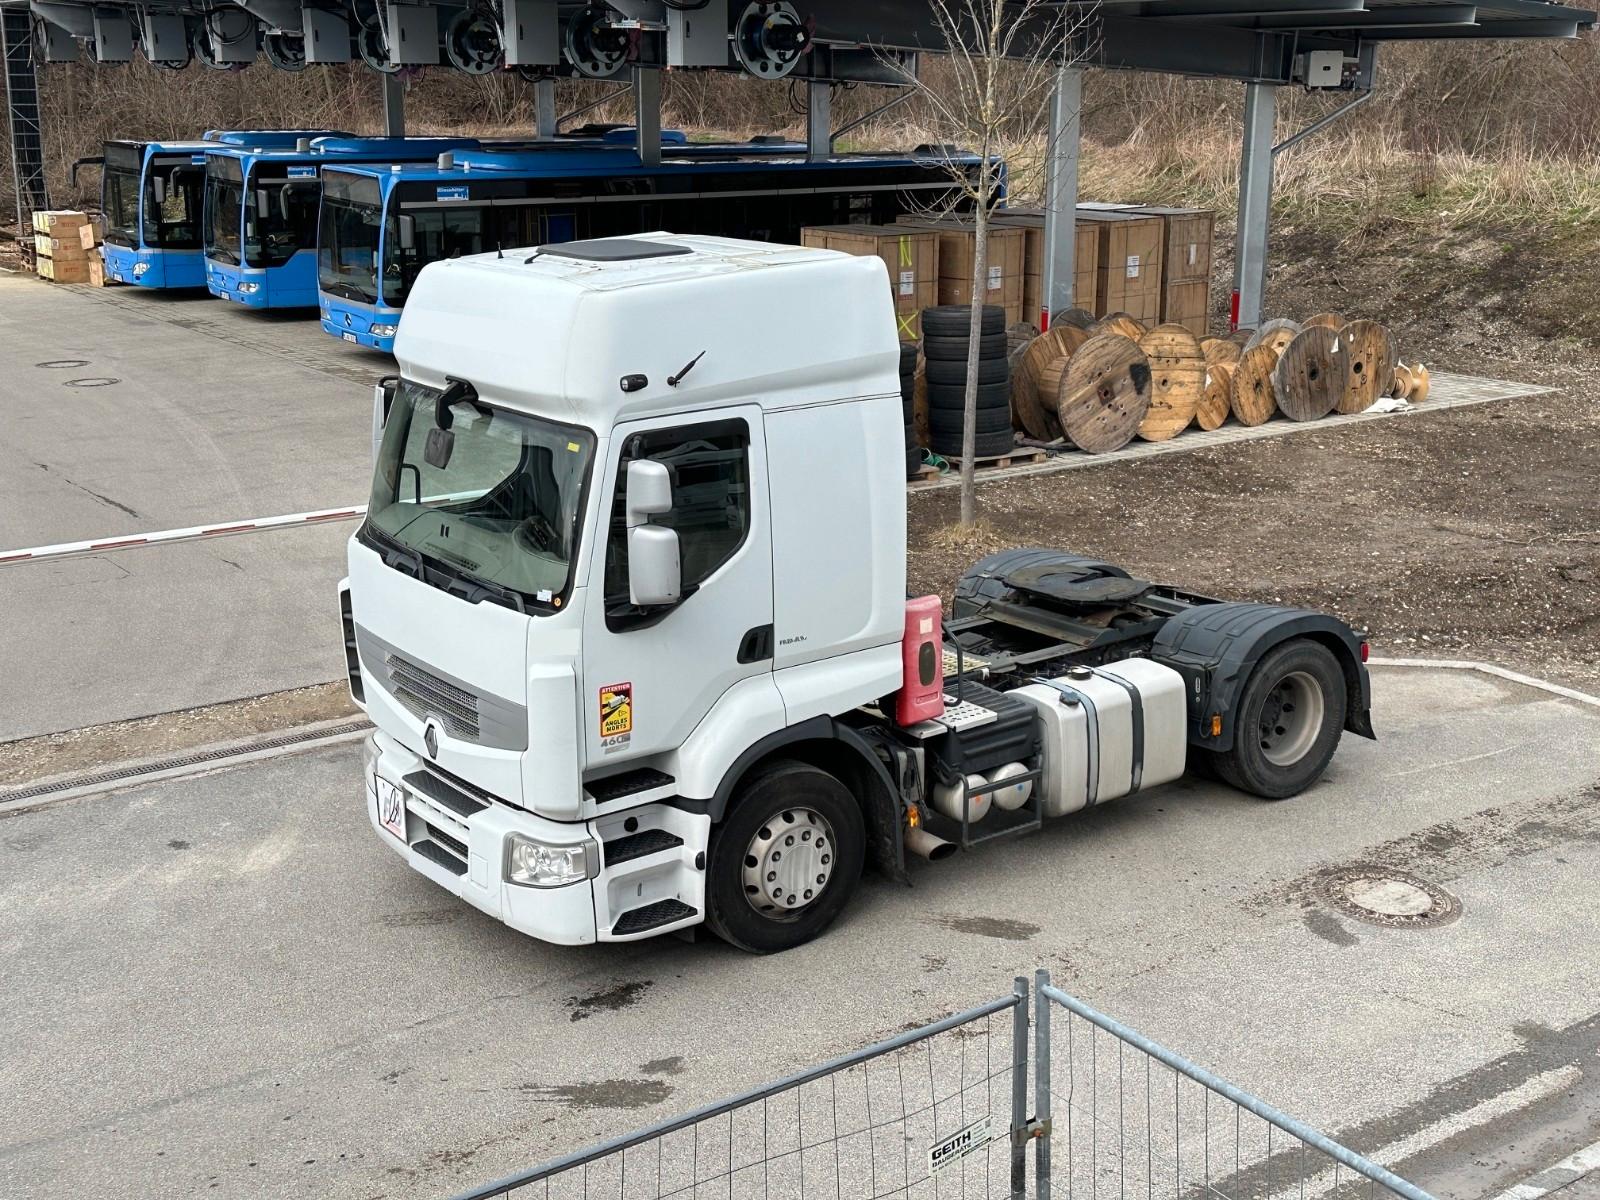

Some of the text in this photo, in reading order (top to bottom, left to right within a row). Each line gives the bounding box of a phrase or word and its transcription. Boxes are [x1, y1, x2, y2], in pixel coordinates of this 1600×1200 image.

[606, 718, 627, 726] ANGLES
[606, 724, 626, 732] MORTS
[932, 1131, 971, 1161] GEITH
